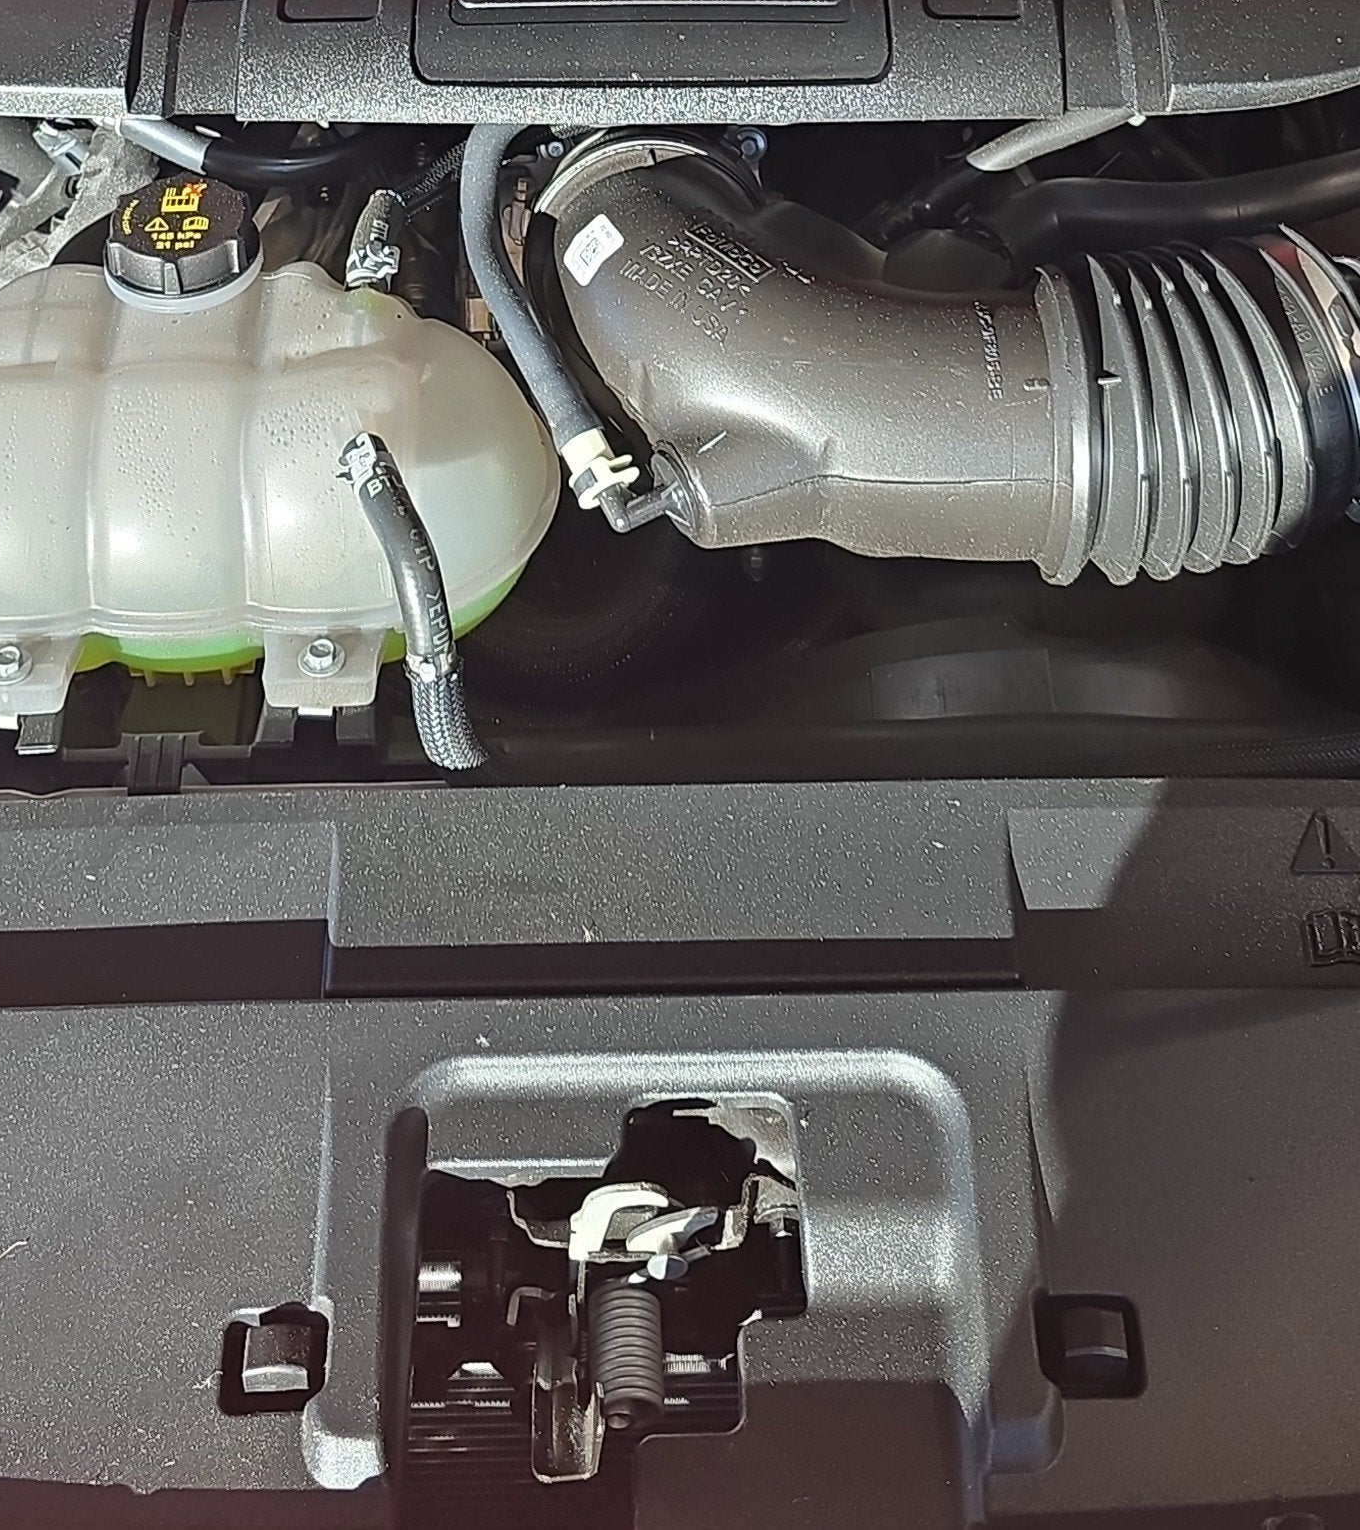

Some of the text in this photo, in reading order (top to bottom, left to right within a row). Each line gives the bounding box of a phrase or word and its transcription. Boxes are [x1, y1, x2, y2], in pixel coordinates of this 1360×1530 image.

[150, 231, 202, 241] 145 kPa
[155, 240, 195, 251] 21 psi
[618, 257, 731, 345] MADE IN USA
